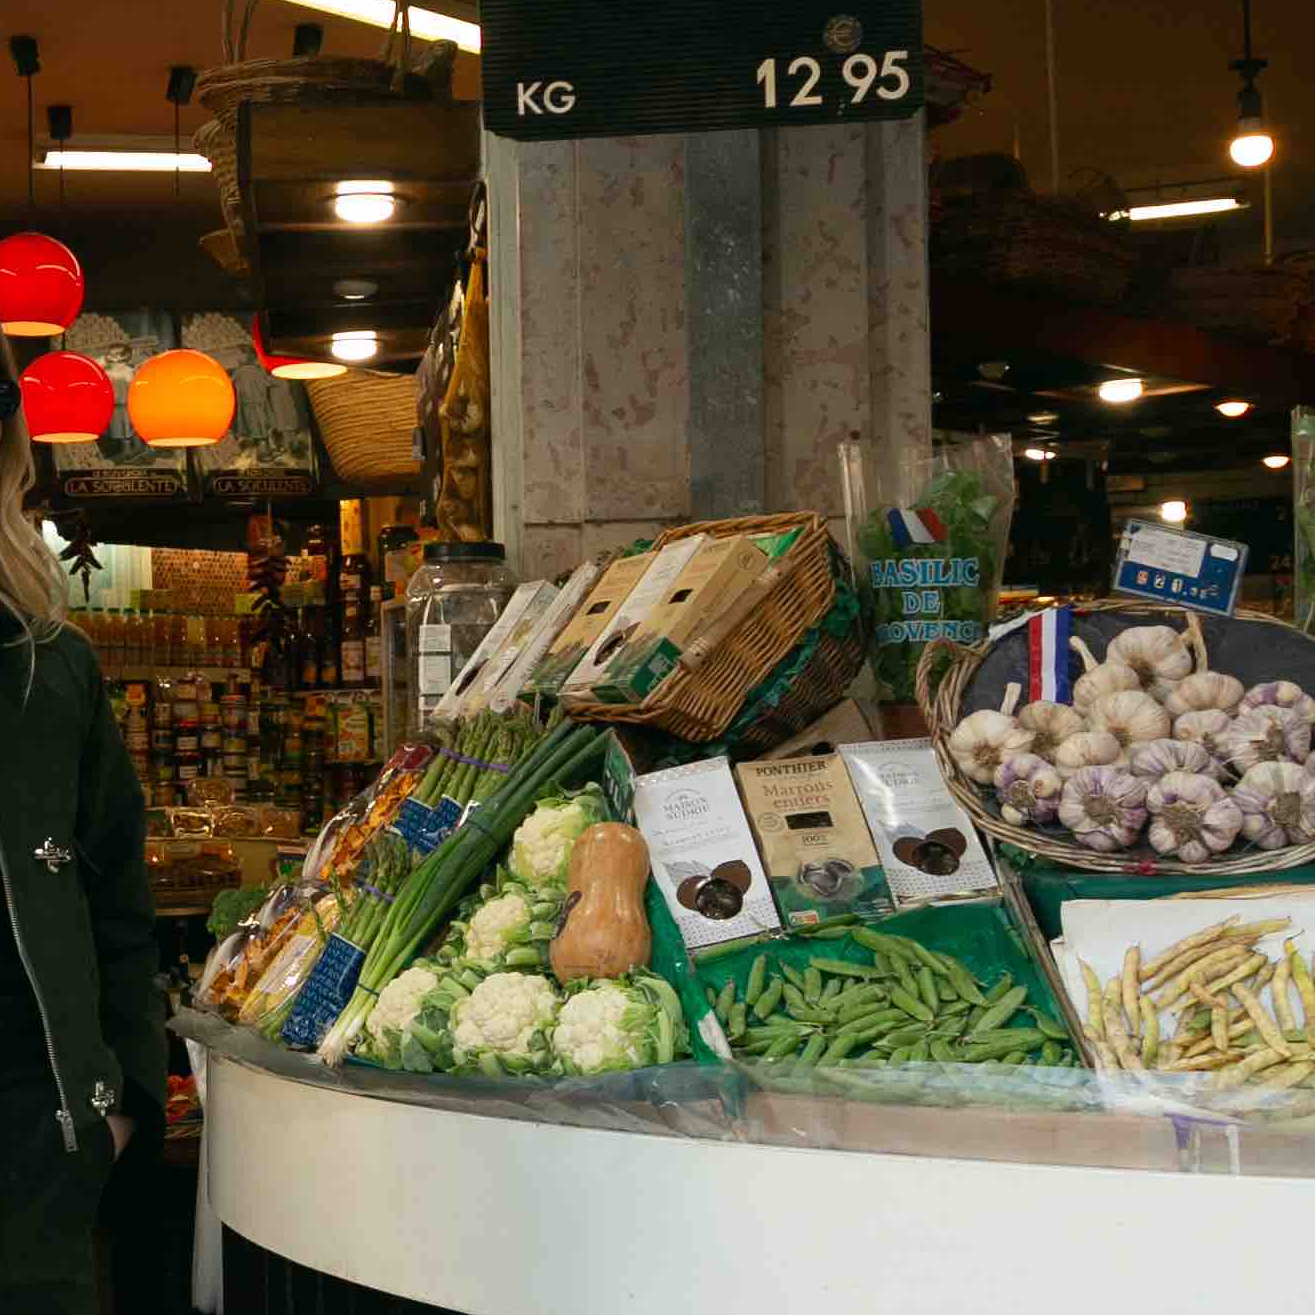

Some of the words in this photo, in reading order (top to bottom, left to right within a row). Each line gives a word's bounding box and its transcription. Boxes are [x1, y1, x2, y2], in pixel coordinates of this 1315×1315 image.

[516, 80, 576, 116] KG
[901, 589, 942, 615] DE
[755, 759, 827, 778] PONTHIER
[763, 780, 834, 798] Marrons
[772, 793, 830, 809] entiers
